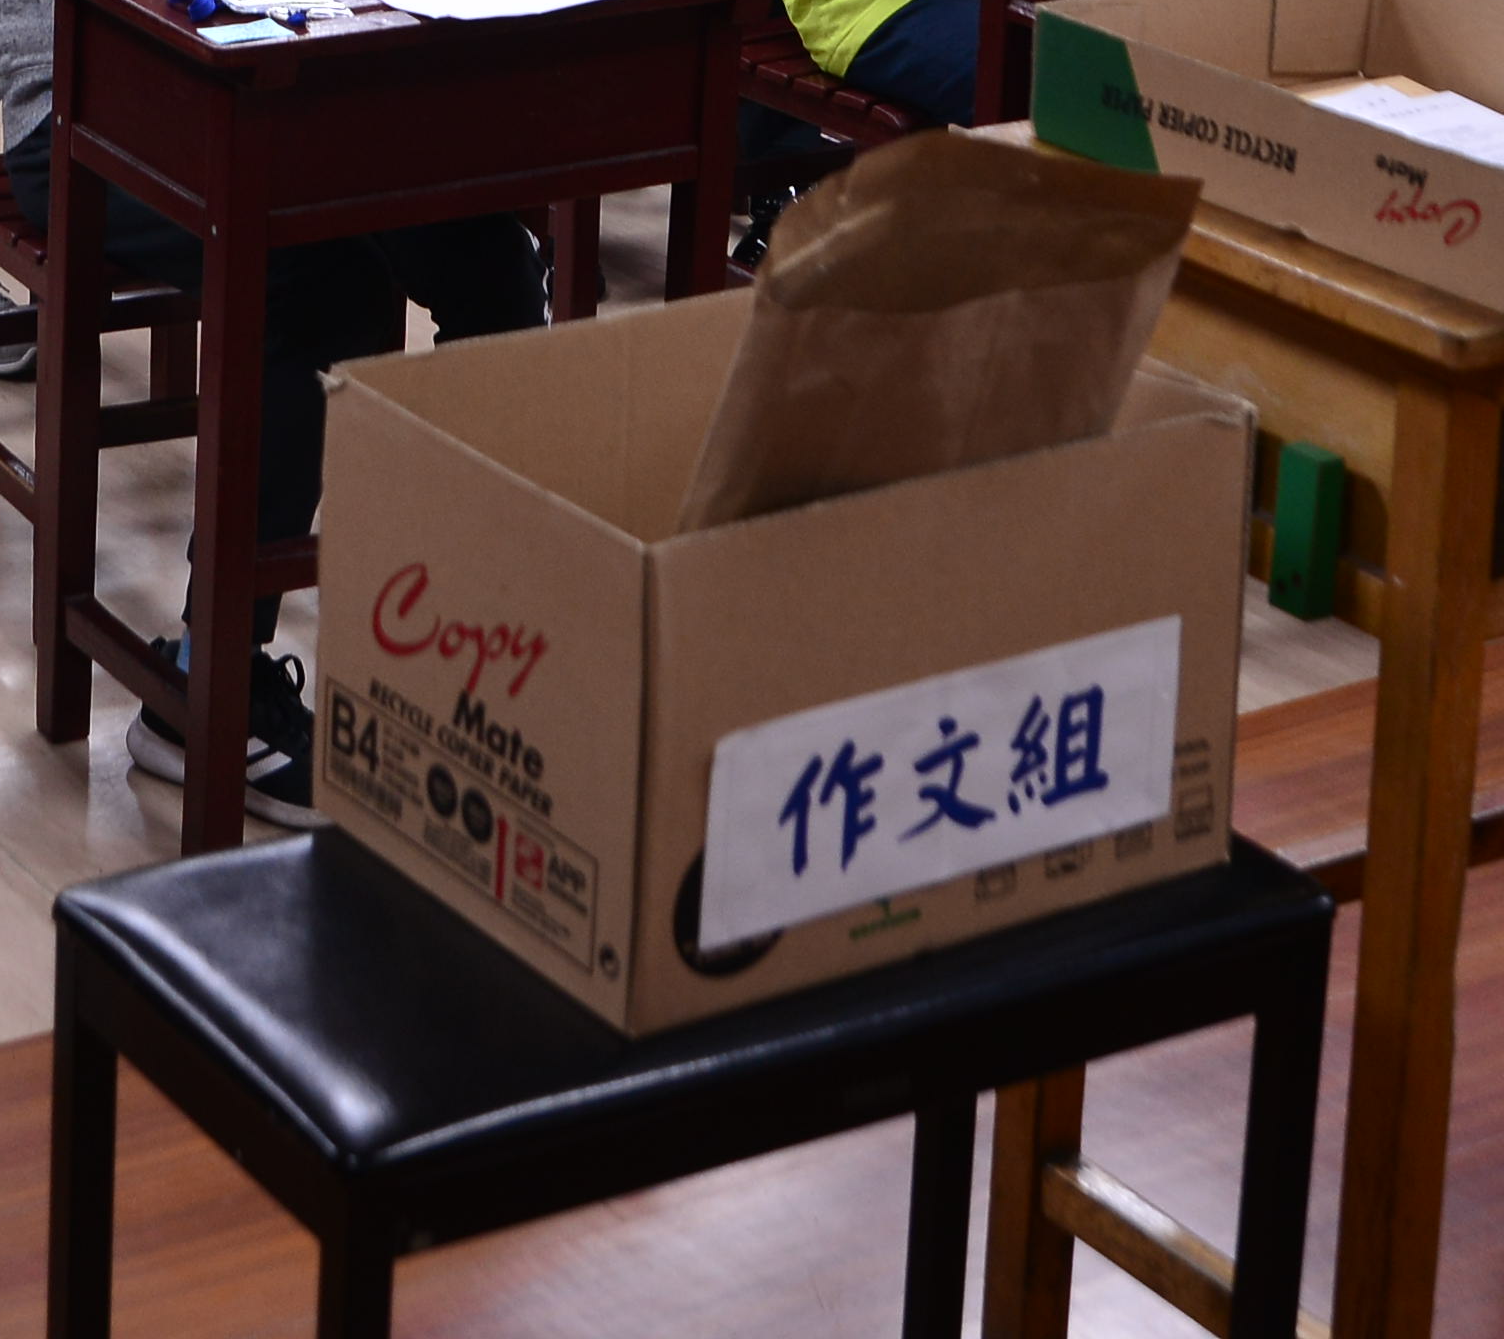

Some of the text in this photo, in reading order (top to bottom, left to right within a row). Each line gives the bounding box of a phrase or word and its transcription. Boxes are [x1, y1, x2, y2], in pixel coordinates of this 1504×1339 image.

[1158, 101, 1219, 144] COPIER
[1223, 125, 1297, 173] RECYCLE
[372, 563, 548, 696] Copy
[331, 692, 379, 773] B4
[369, 678, 434, 736] RECYCLE
[437, 726, 493, 775] COPIER
[498, 765, 553, 817] PAPER
[453, 689, 544, 779] Mate
[779, 684, 1109, 876] 作文組
